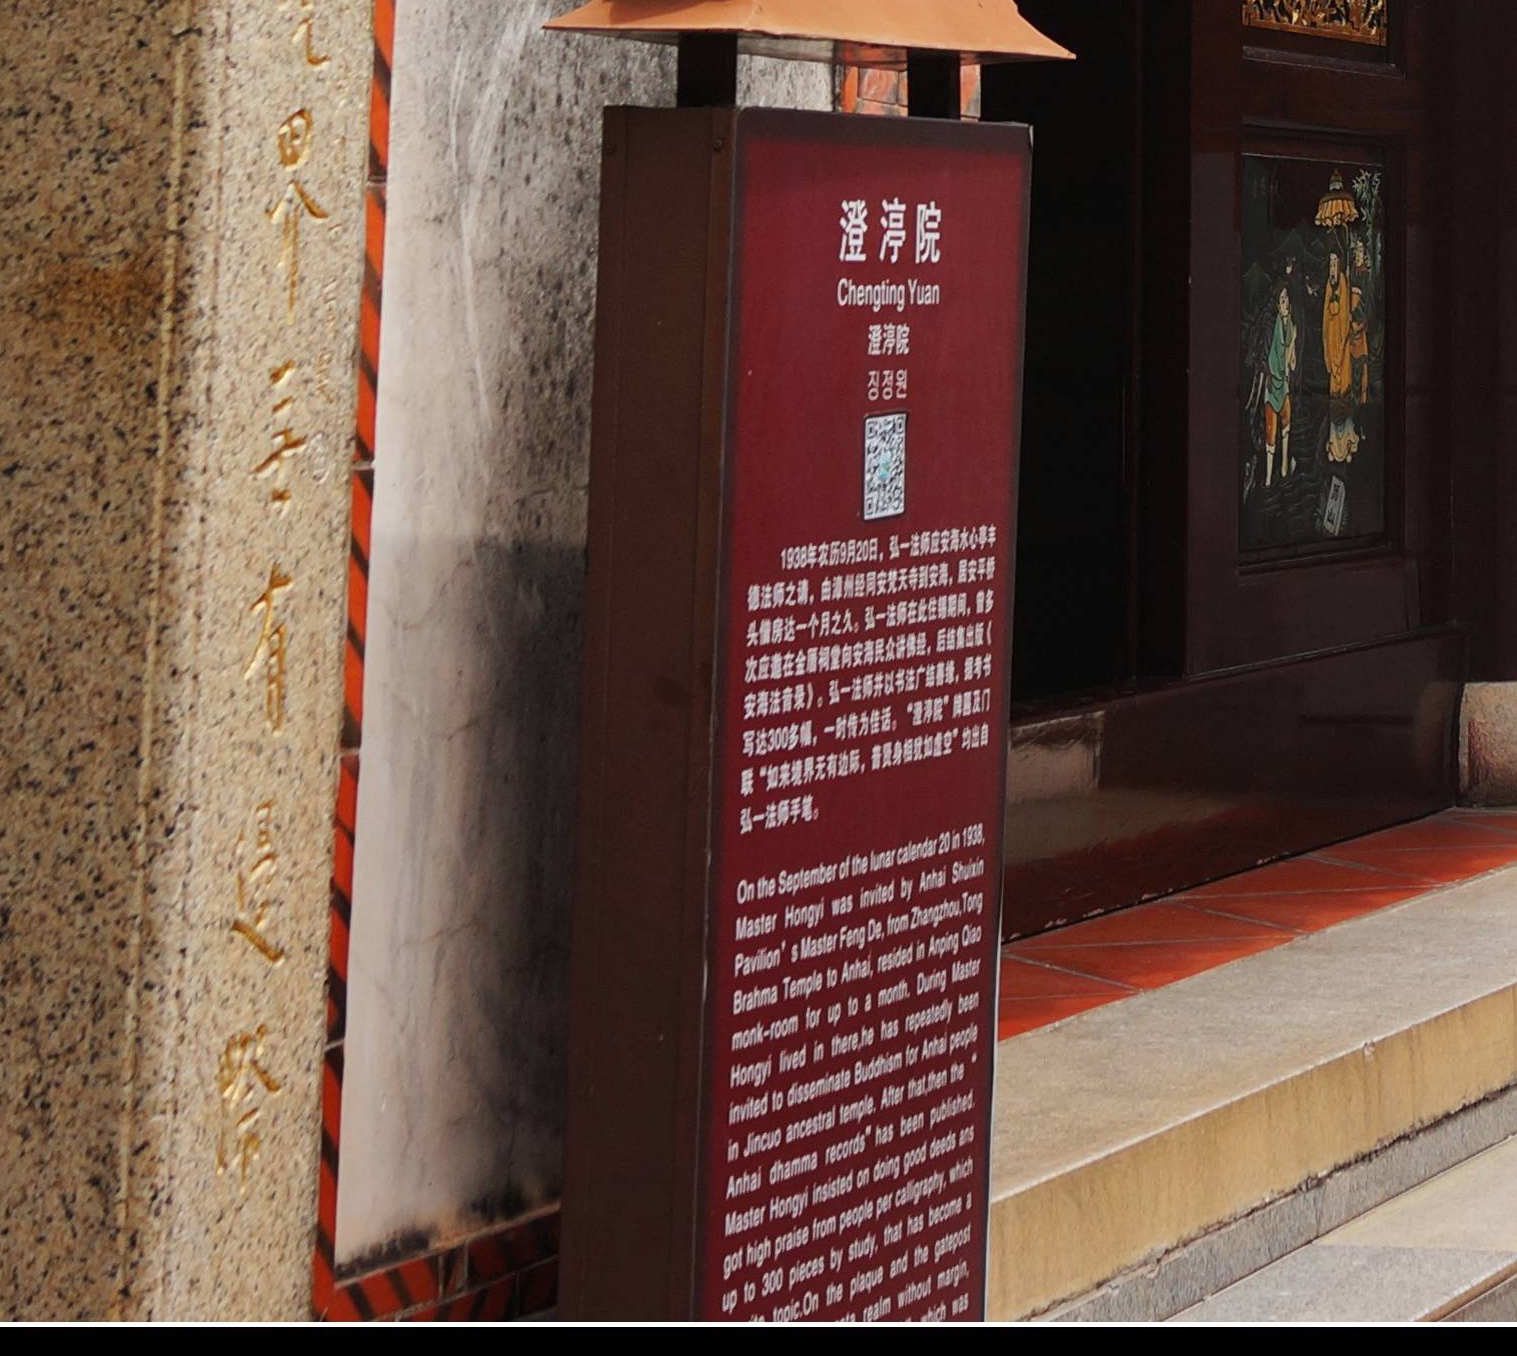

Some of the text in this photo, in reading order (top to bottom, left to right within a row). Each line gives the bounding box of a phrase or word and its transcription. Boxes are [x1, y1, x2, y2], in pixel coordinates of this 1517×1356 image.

[838, 196, 942, 265] 澄渟院
[837, 278, 940, 313] Chengting Yuan
[735, 859, 984, 940] Master Hongyi was invited by Anhai Shuixin
[737, 879, 755, 904] On
[757, 876, 776, 899] the
[777, 863, 838, 895] September
[838, 855, 850, 880] of
[851, 854, 869, 876] the
[869, 849, 896, 871] lunar
[896, 838, 938, 865] calendar
[938, 831, 951, 855] 20
[951, 831, 961, 850] in
[733, 985, 778, 1015] Brahma
[782, 971, 823, 1000] Temple
[826, 968, 838, 988] to
[877, 943, 913, 972] resided
[916, 942, 925, 961] in
[928, 932, 959, 958] Anping
[961, 924, 982, 947] Qiao
[800, 933, 838, 959] Master
[839, 926, 866, 950] Feng
[886, 914, 909, 935] from
[730, 1055, 772, 1088] Hongyi
[779, 1044, 807, 1073] lived
[813, 1043, 824, 1062] in
[880, 1019, 899, 1040] has
[905, 999, 953, 1033] repeatedly
[957, 992, 979, 1014] been
[731, 1015, 799, 1050] monk-room
[805, 1007, 822, 1029] for
[827, 1003, 842, 1026] up
[847, 997, 859, 1016] to
[864, 993, 872, 1011] a
[916, 969, 947, 995] During
[951, 958, 981, 983] Master
[727, 1140, 739, 1161] in
[743, 1128, 782, 1157] Jincuo
[785, 1105, 836, 1143] ancestral
[880, 1085, 905, 1109] After
[950, 1063, 965, 1083] the
[729, 1023, 978, 1124] invited to disseminate Buddhism for Anhai people
[725, 1206, 766, 1236] Master
[769, 1192, 809, 1220] Hongyi
[812, 1170, 853, 1205] insisted
[856, 1167, 870, 1189] on
[873, 1155, 900, 1182] doing
[903, 1141, 927, 1175] good
[929, 1131, 956, 1159] deeds
[726, 1167, 762, 1199] Anhai
[769, 1151, 818, 1185] dhamma
[875, 1123, 894, 1145] has
[900, 1112, 924, 1137] been
[722, 1289, 738, 1314] up
[743, 1282, 756, 1303] to
[761, 1267, 784, 1296] 300
[789, 1256, 825, 1290] pieces
[830, 1248, 843, 1271] by
[883, 1221, 903, 1246] that
[907, 1214, 924, 1235] has
[928, 1197, 962, 1227] become
[966, 1192, 972, 1210] a
[723, 1248, 743, 1280] got
[746, 1238, 771, 1268] high
[774, 1226, 809, 1260] praise
[812, 1215, 837, 1240] from
[839, 1199, 874, 1235] people
[876, 1193, 893, 1219] per
[949, 1158, 973, 1183] which
[826, 1283, 844, 1306] the
[850, 1265, 884, 1300] plaque
[889, 1251, 908, 1278] and
[914, 1245, 929, 1267] the
[934, 1224, 971, 1263] gatepost
[863, 1296, 892, 1321] realm
[897, 1276, 932, 1309] without
[951, 1292, 970, 1317] was
